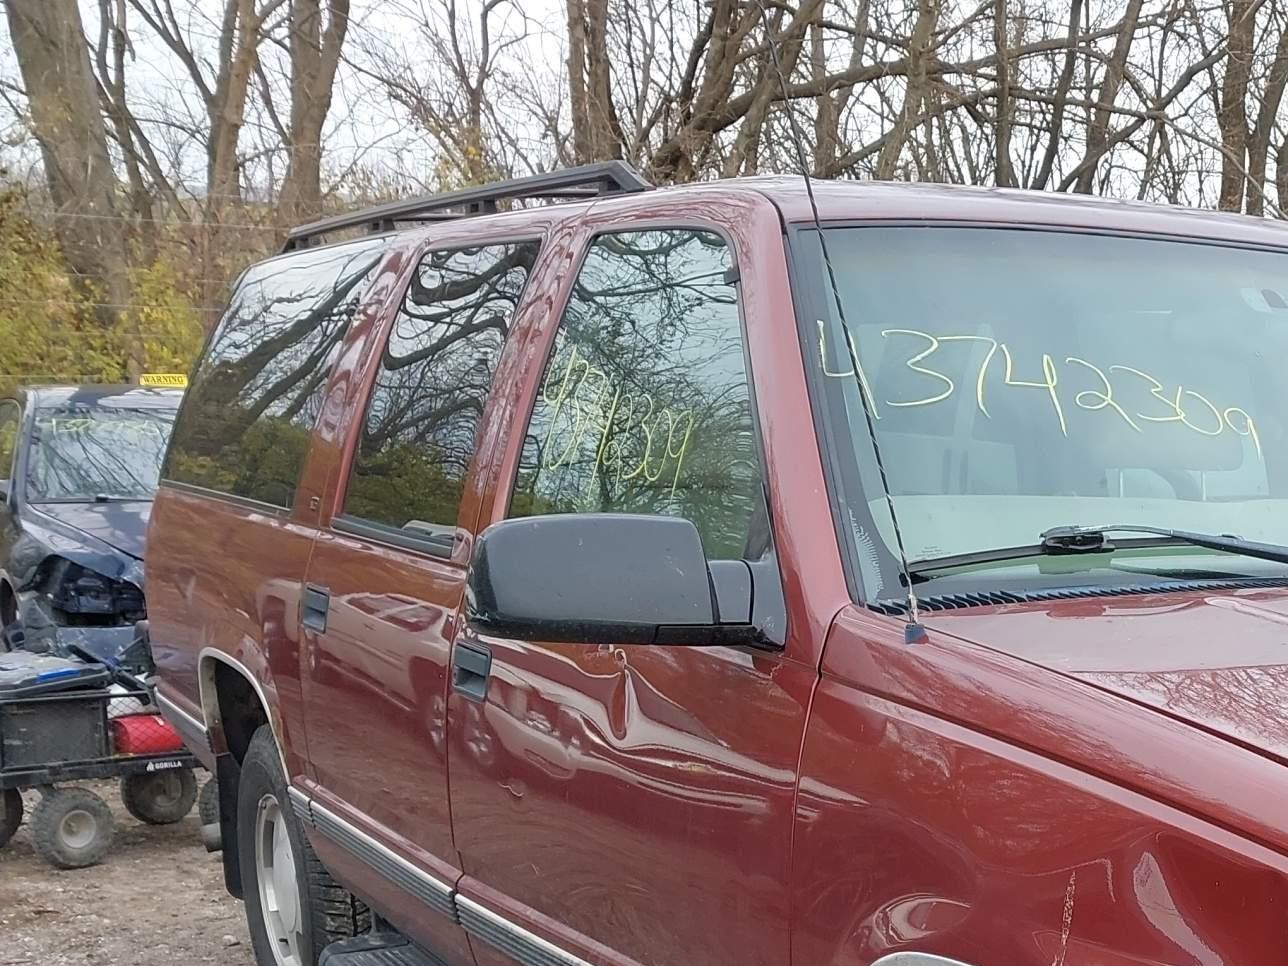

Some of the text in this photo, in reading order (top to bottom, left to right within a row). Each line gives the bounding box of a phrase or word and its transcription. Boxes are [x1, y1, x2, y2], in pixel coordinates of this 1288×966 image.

[143, 375, 184, 385] WARNING
[816, 319, 1263, 461] 43742309
[155, 761, 182, 770] GORILLA
